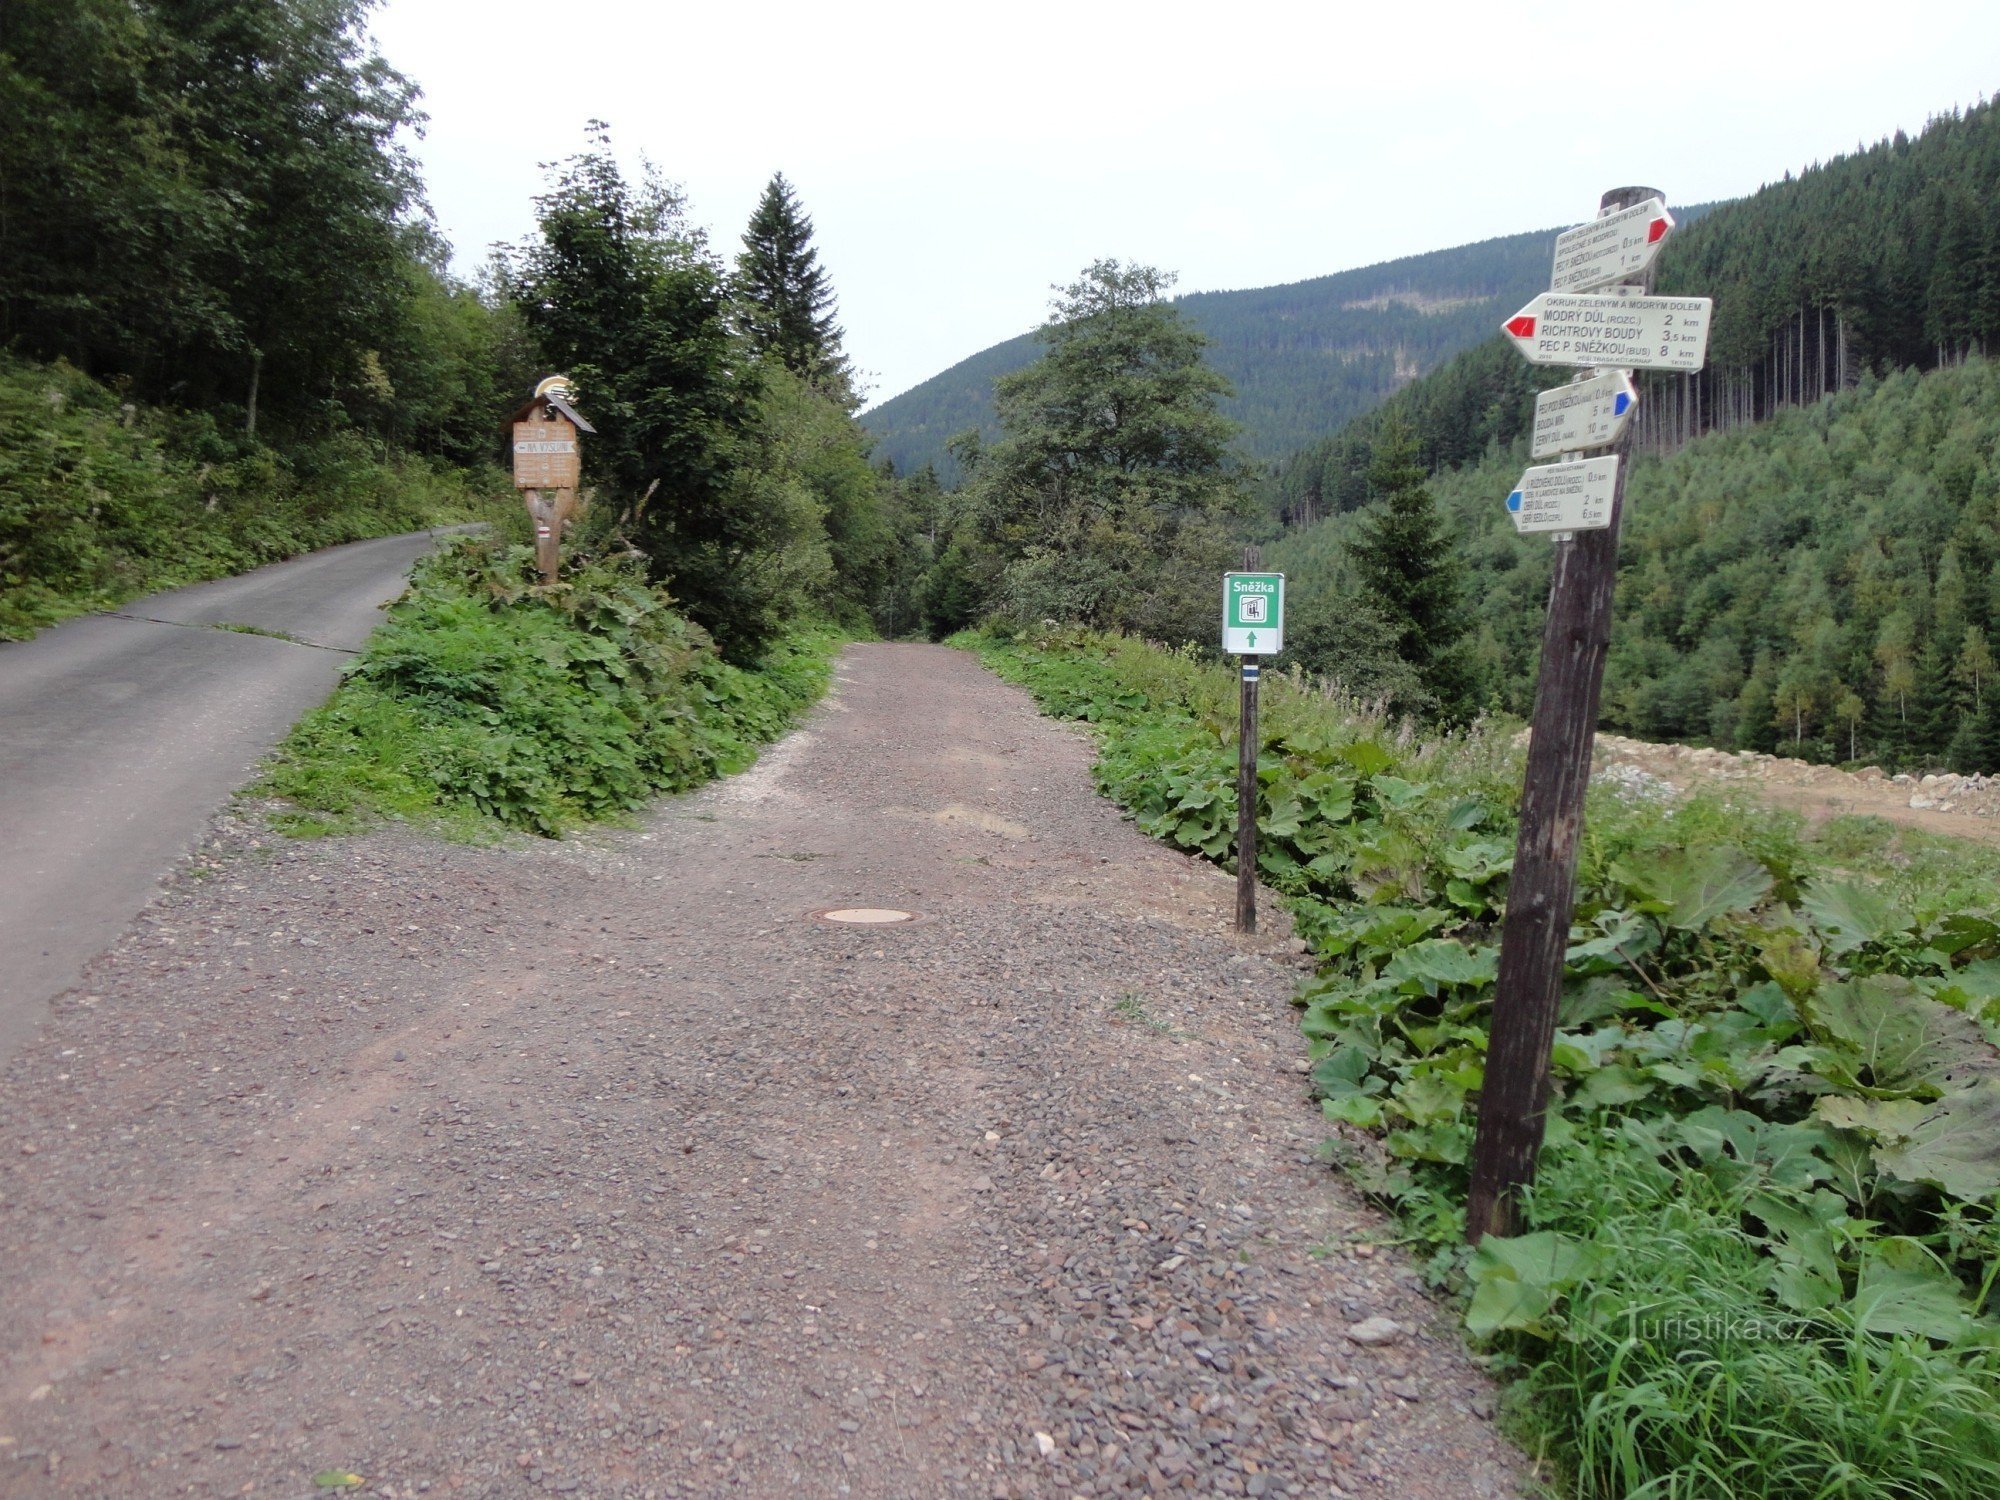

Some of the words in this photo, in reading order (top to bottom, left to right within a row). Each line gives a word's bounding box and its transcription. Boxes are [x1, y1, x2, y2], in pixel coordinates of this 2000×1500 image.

[1546, 298, 1577, 306] OKRUH
[1628, 300, 1667, 310] MODRÝM
[1670, 303, 1702, 311] DOLEM
[1543, 309, 1581, 322] MODRÝ
[1664, 315, 1673, 326] 2
[1683, 318, 1699, 327] km
[1541, 325, 1602, 338] RICHTROVY
[1604, 328, 1643, 339] BOUDY
[1681, 333, 1696, 342] km
[1539, 340, 1561, 351] PEC
[1574, 339, 1625, 354] SNĚŽKOU
[1625, 347, 1651, 356] (BUS)
[1660, 345, 1669, 357] 8
[1679, 349, 1694, 358] km
[1593, 406, 1598, 416] 5
[1584, 495, 1590, 505] 2
[1233, 581, 1274, 592] Sněžka
